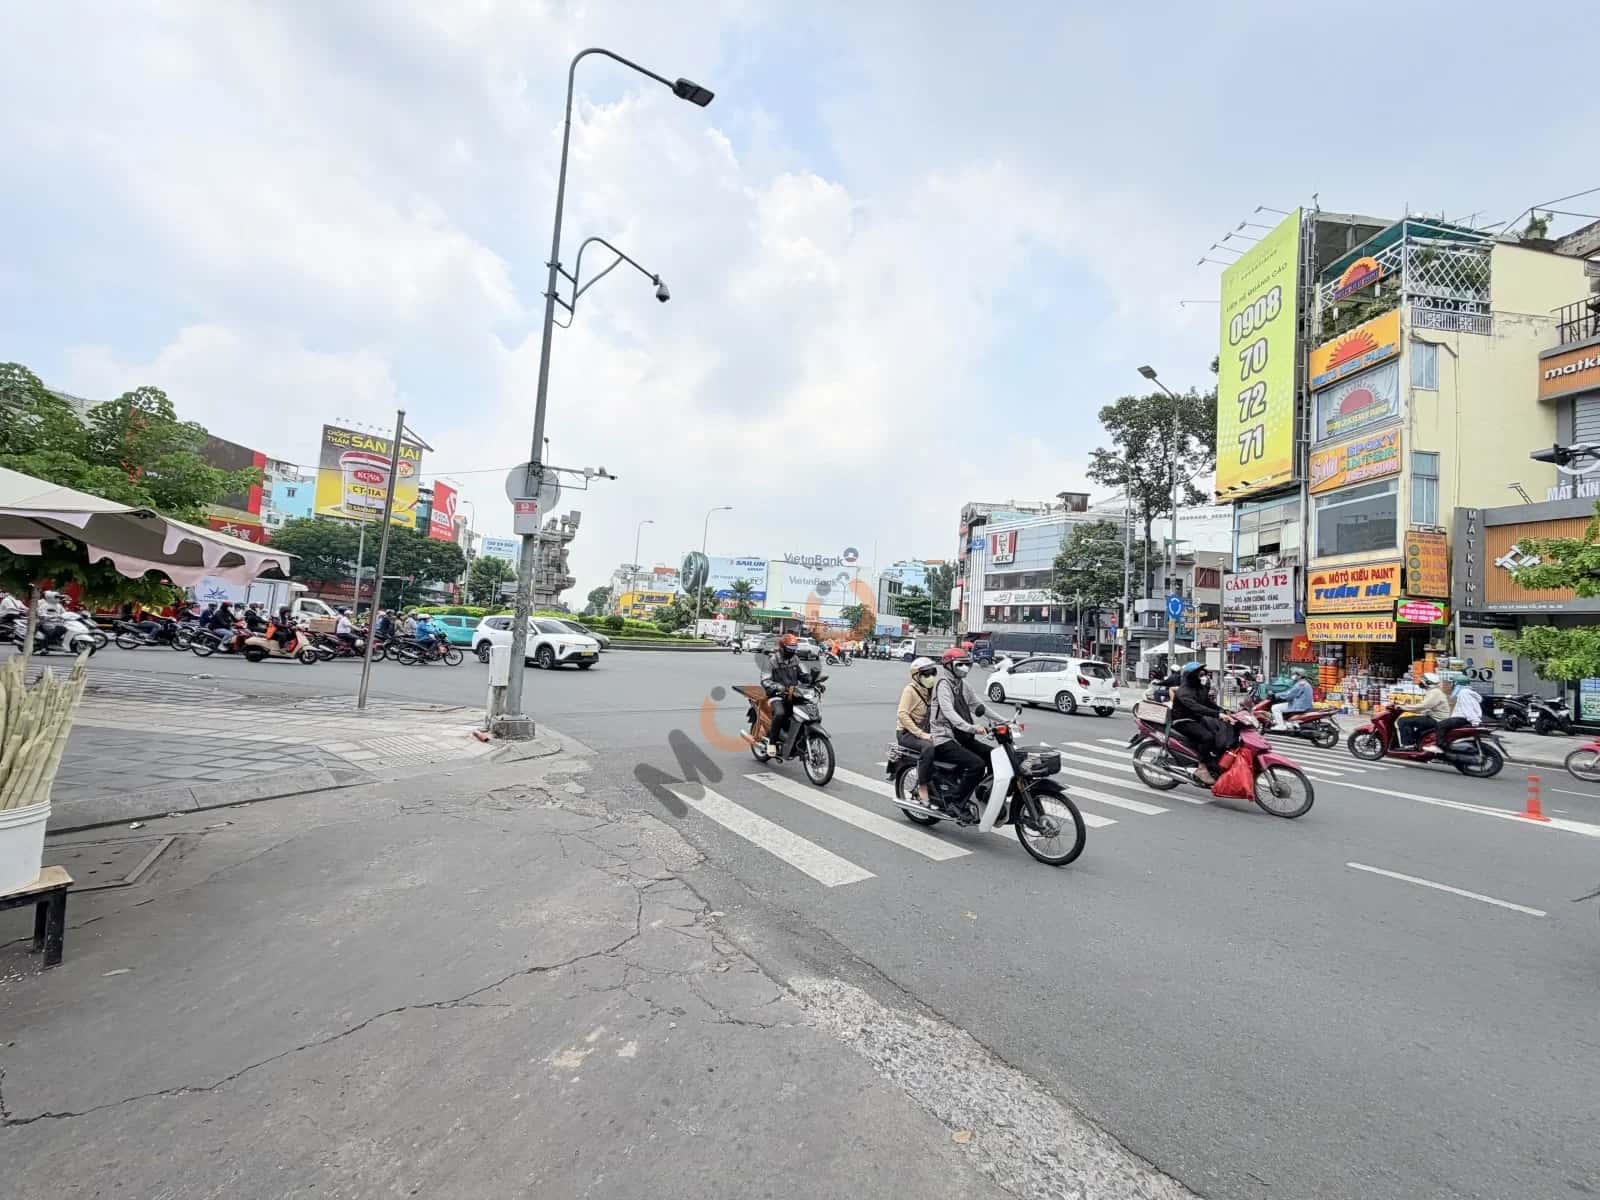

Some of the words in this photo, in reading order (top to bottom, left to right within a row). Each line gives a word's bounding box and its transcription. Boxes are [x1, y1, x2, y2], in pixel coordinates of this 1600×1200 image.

[1229, 284, 1282, 346] 0908
[1239, 336, 1268, 382] 70
[1238, 380, 1267, 423] 72
[1238, 423, 1265, 465] 71
[357, 471, 382, 482] KOVA
[351, 486, 382, 497] CT-11A
[736, 560, 767, 568] SAILUN
[784, 552, 845, 567] VietinBank
[995, 554, 1011, 562] KFC
[1371, 567, 1395, 580] PAINT
[1272, 574, 1288, 587] T2
